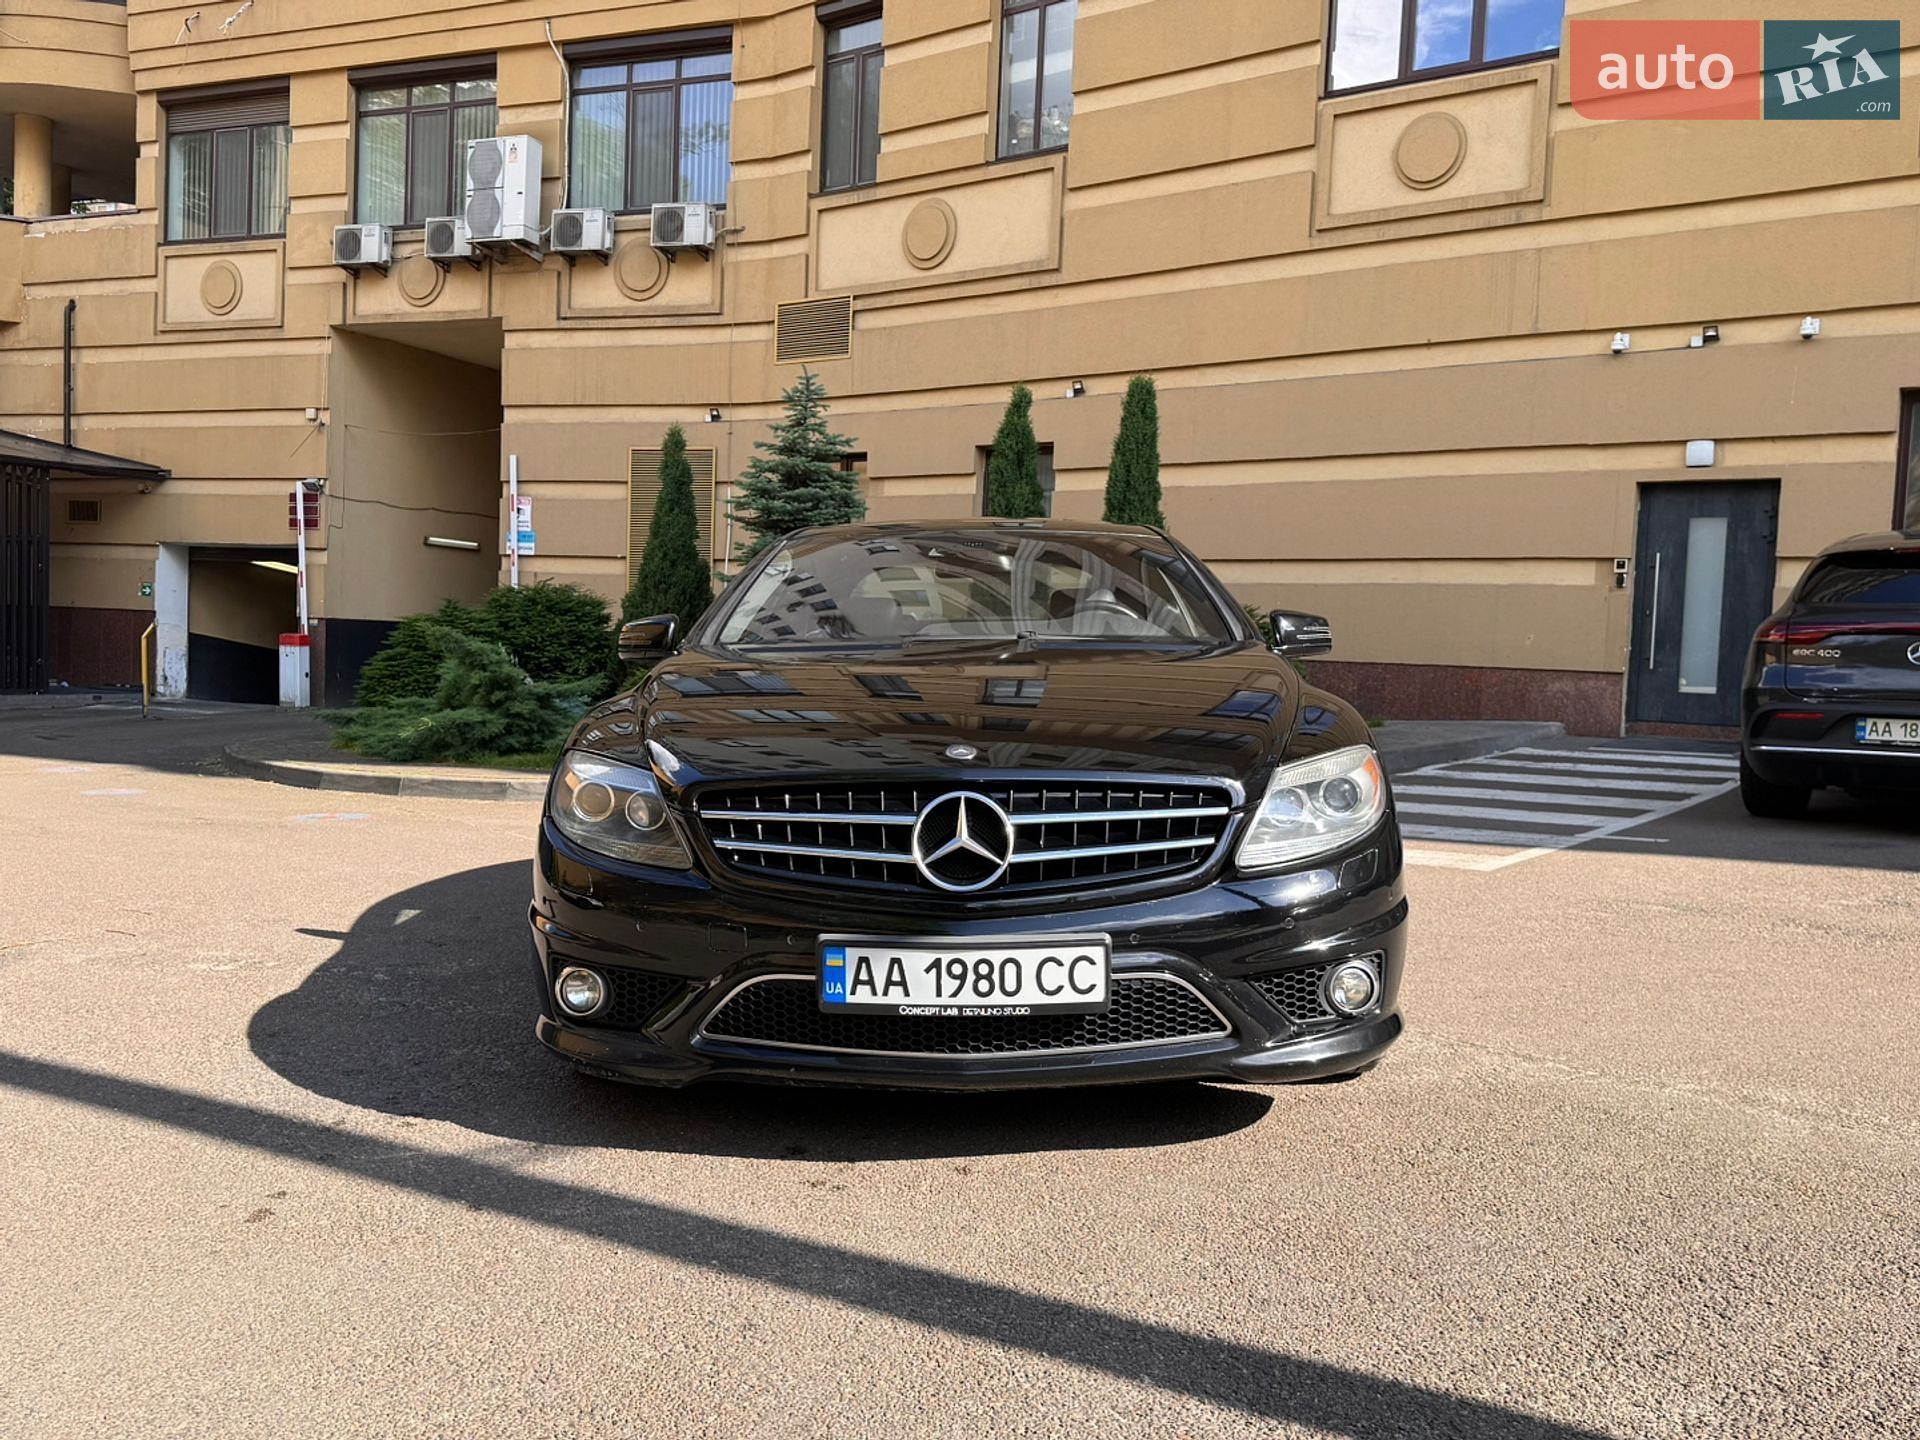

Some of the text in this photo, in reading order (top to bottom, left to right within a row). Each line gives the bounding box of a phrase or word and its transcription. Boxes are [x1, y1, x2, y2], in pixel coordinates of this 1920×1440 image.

[1817, 649, 1841, 657] 400
[1868, 721, 1892, 737] AA
[849, 955, 1097, 999] AA 1980 CC
[826, 982, 843, 995] UA
[899, 1005, 939, 1015] CONCEPT
[941, 1006, 959, 1015] LAB
[1002, 1006, 1031, 1015] STUDIO
